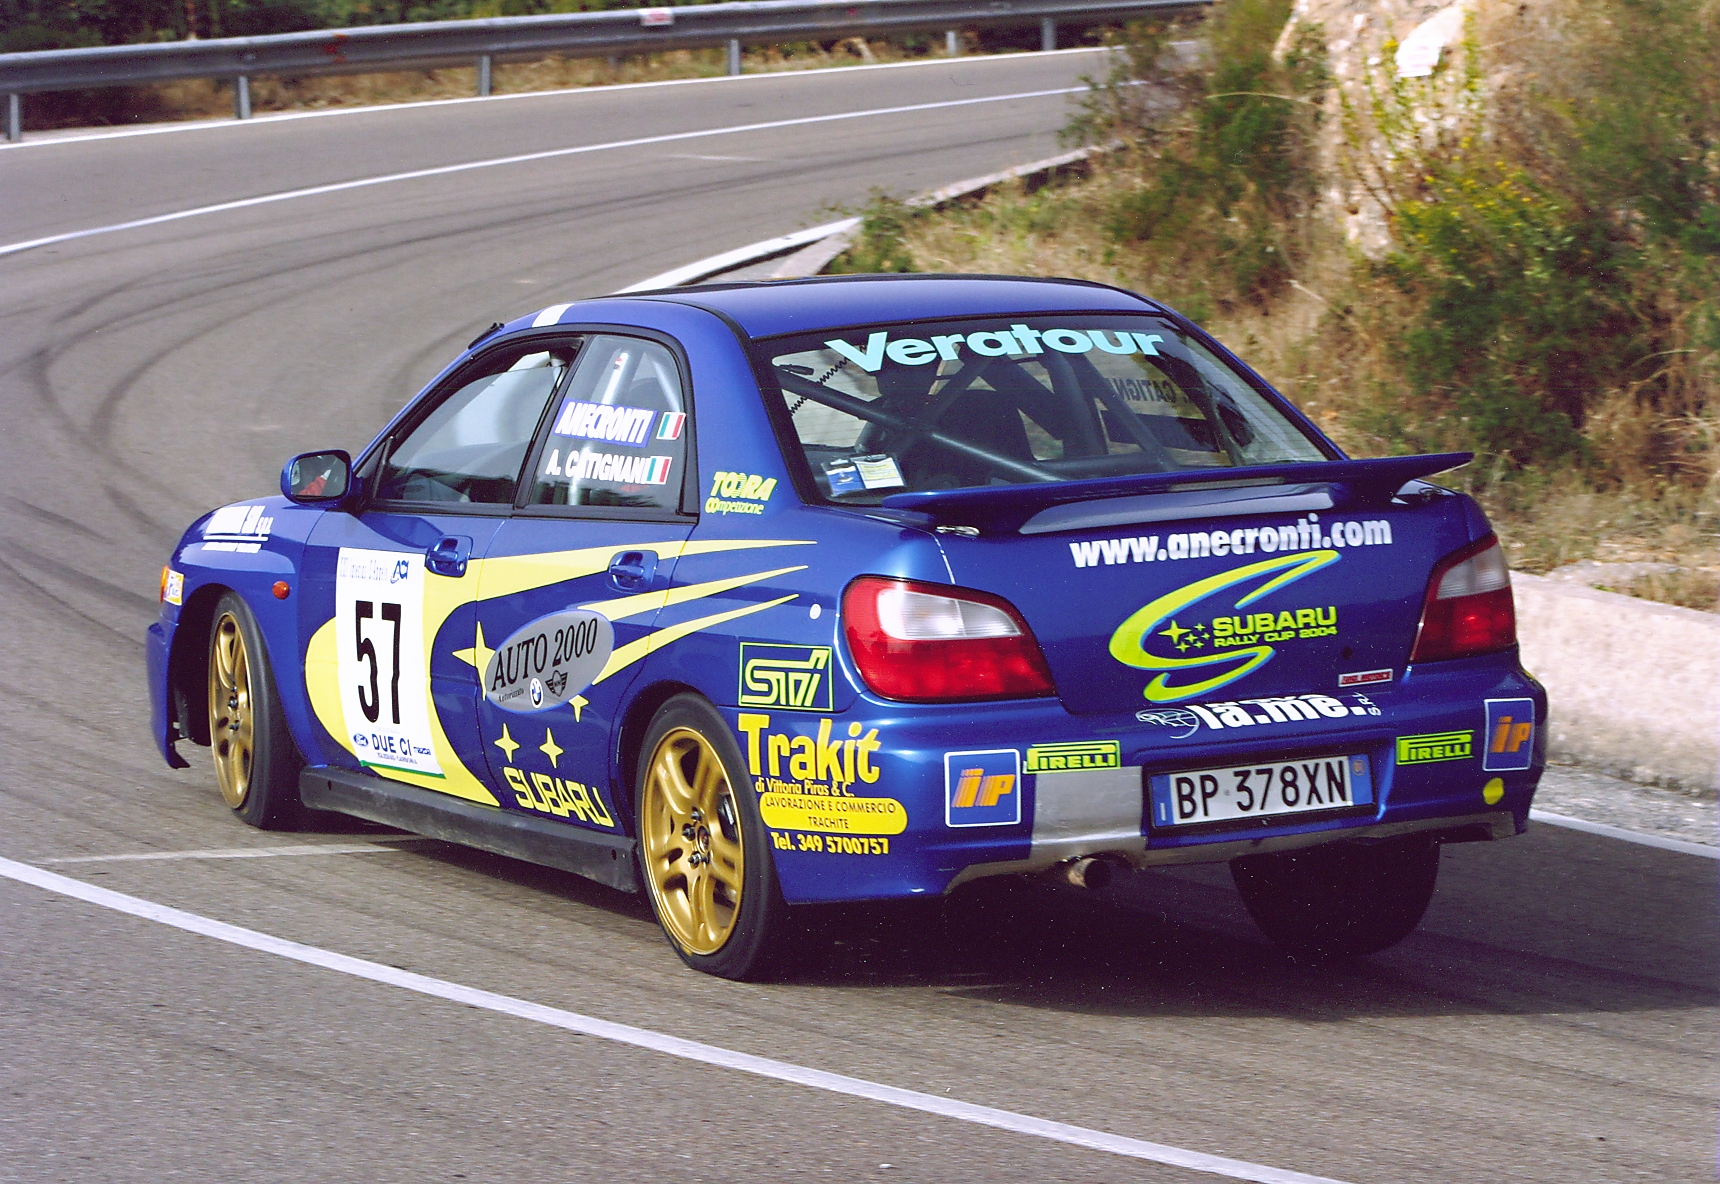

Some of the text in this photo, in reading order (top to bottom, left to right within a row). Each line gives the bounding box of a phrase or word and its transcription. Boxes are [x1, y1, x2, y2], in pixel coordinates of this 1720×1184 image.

[824, 324, 1164, 373] Veratour
[555, 402, 653, 444] ANECRONTI
[545, 449, 562, 475] A.
[1069, 513, 1393, 568] www.anecronti.com
[1213, 606, 1337, 638] SUBARU
[1214, 626, 1338, 648] RALLY CUP 2004
[356, 600, 401, 724] 57
[491, 618, 598, 691] AUTO 2000
[371, 733, 397, 753] DUE
[400, 738, 412, 756] CI
[738, 713, 882, 783] Trakit
[1027, 744, 1117, 770] PIRELLI
[1399, 734, 1472, 761] PIRELLI
[503, 766, 614, 828] SUBARU
[755, 776, 765, 792] di
[804, 779, 829, 796] Piras
[830, 780, 841, 796] &
[842, 782, 855, 797] C.
[1176, 760, 1348, 819] BP 378XN
[765, 796, 896, 813] LAVORAZIONE E COMMERCIO
[808, 816, 849, 829] TRACHITE
[770, 832, 889, 854] Tel. 349 5700757
